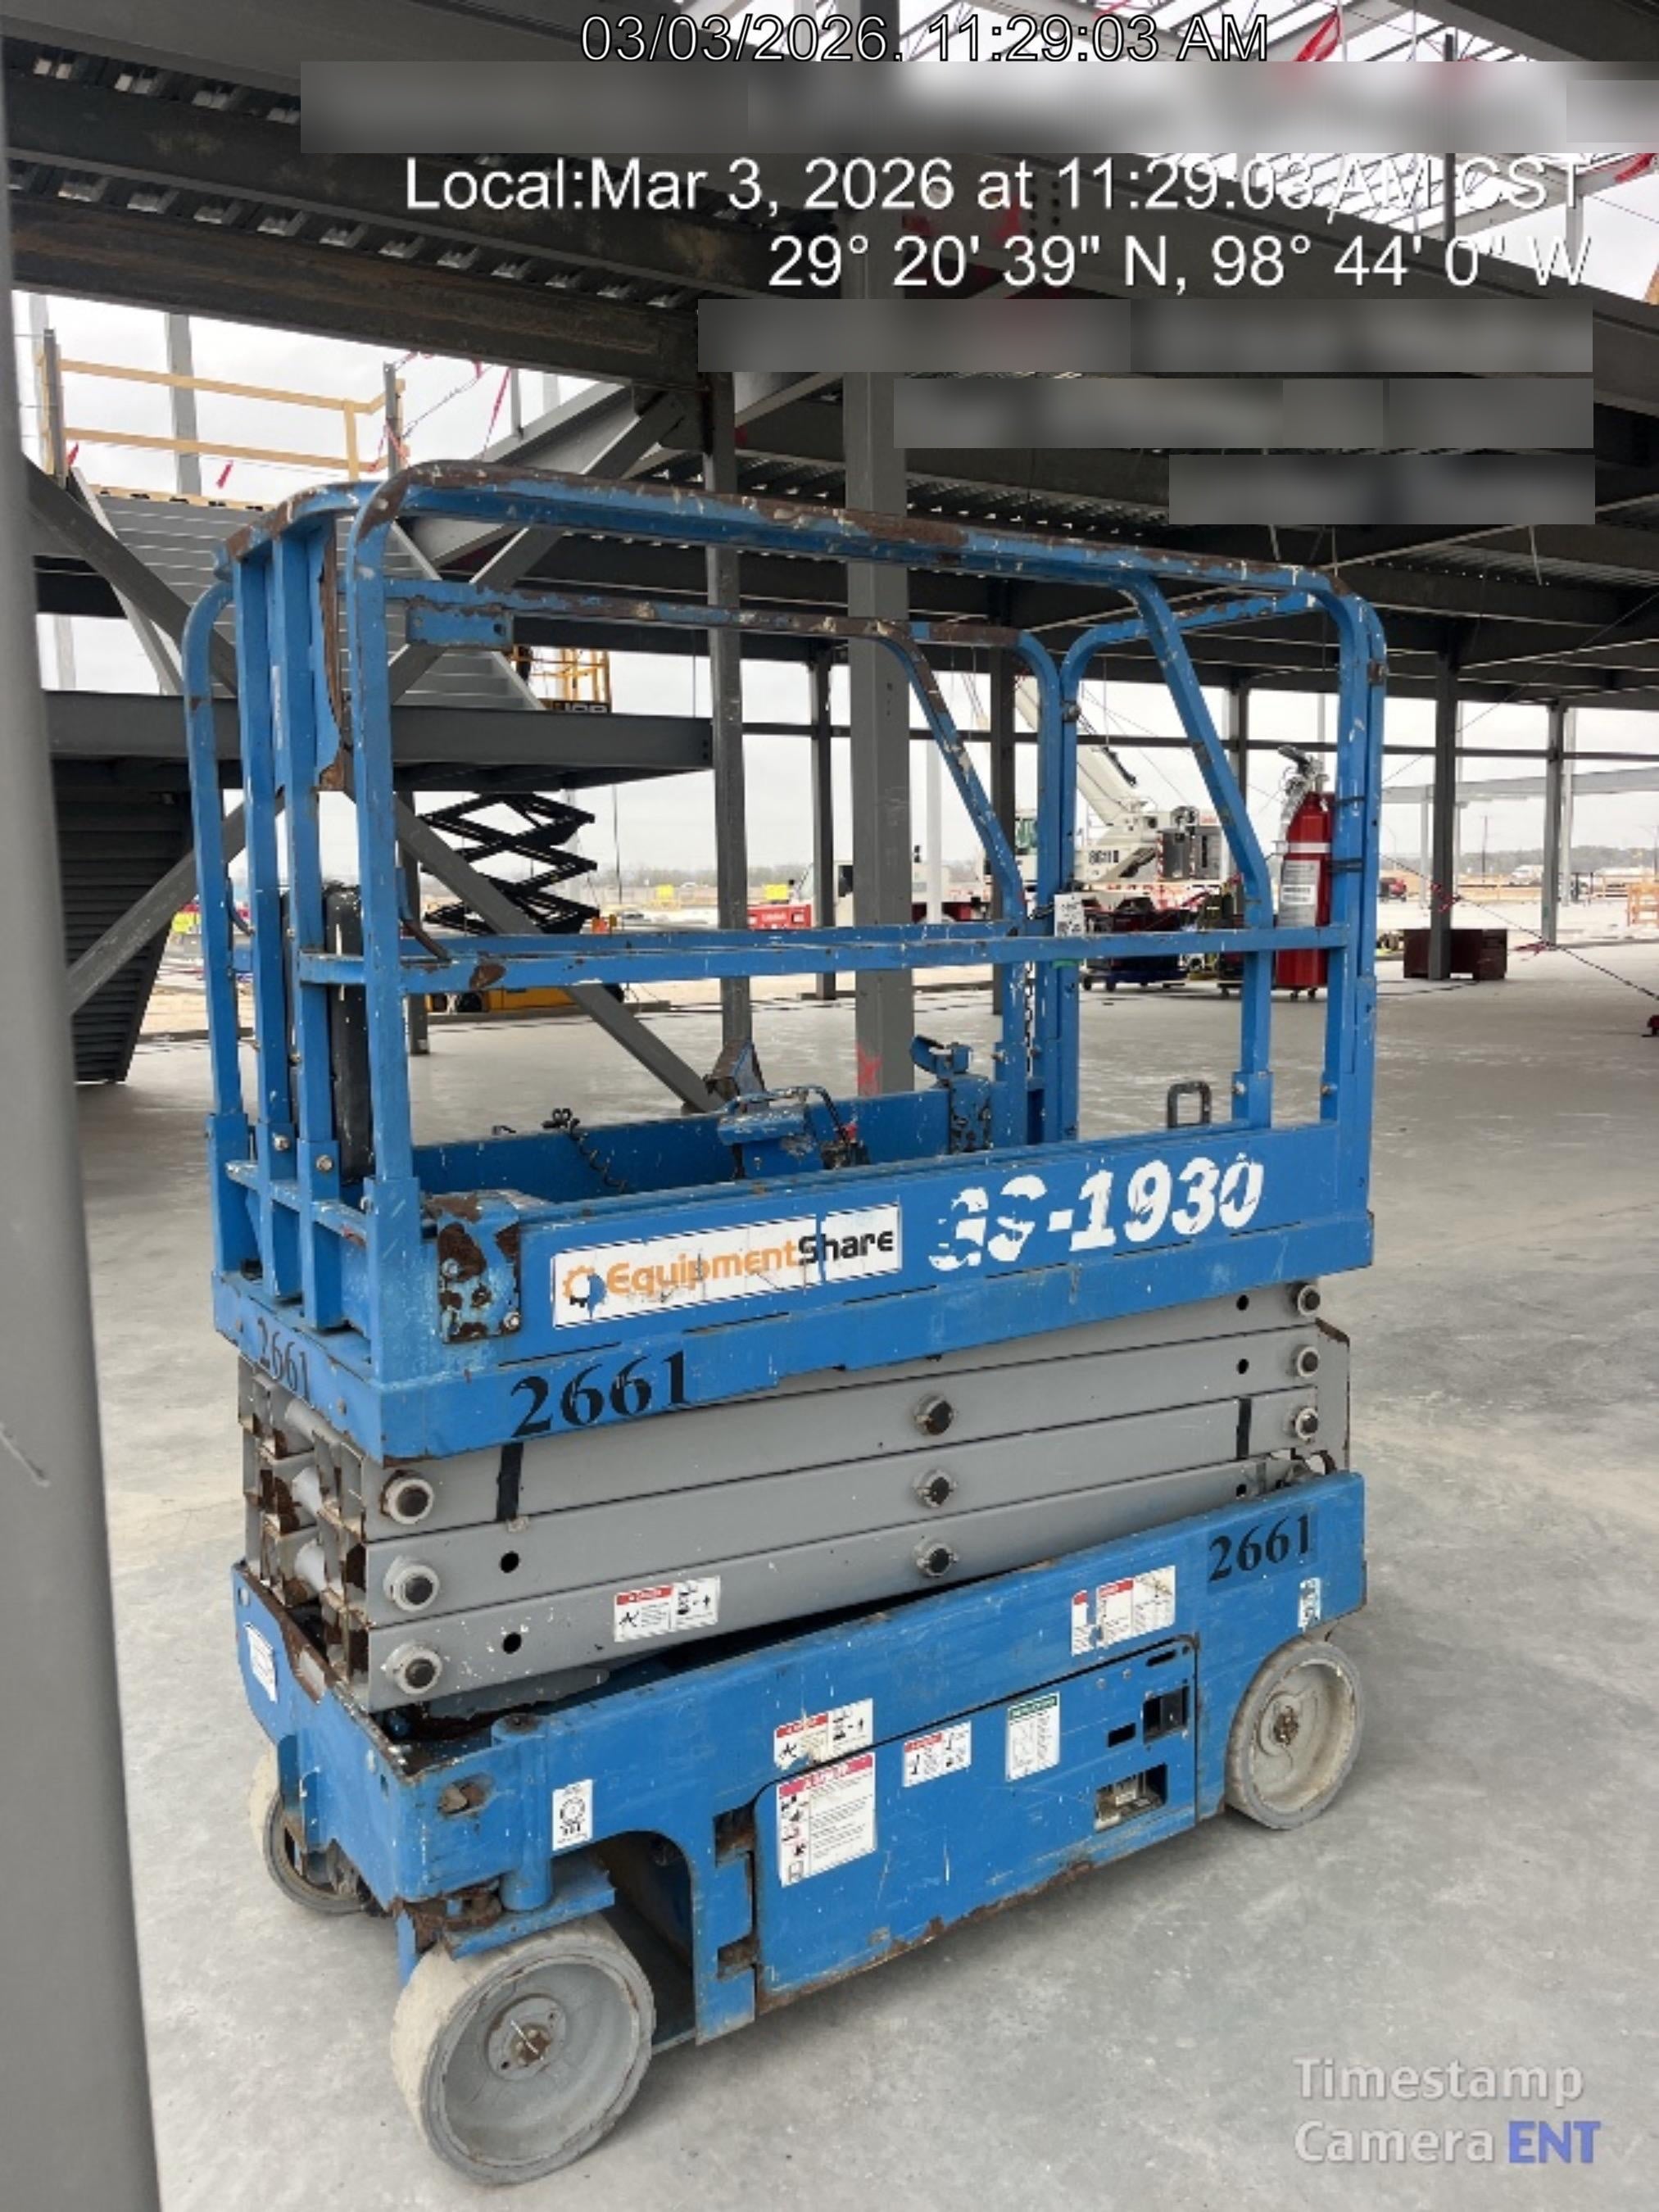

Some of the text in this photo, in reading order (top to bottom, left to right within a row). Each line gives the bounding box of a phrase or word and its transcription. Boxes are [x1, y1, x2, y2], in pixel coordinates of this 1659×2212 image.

[606, 1230, 895, 1298] EquipmentShare
[256, 1317, 310, 1402] 2661
[510, 1349, 690, 1438] 2661
[1208, 1513, 1312, 1582] 2661
